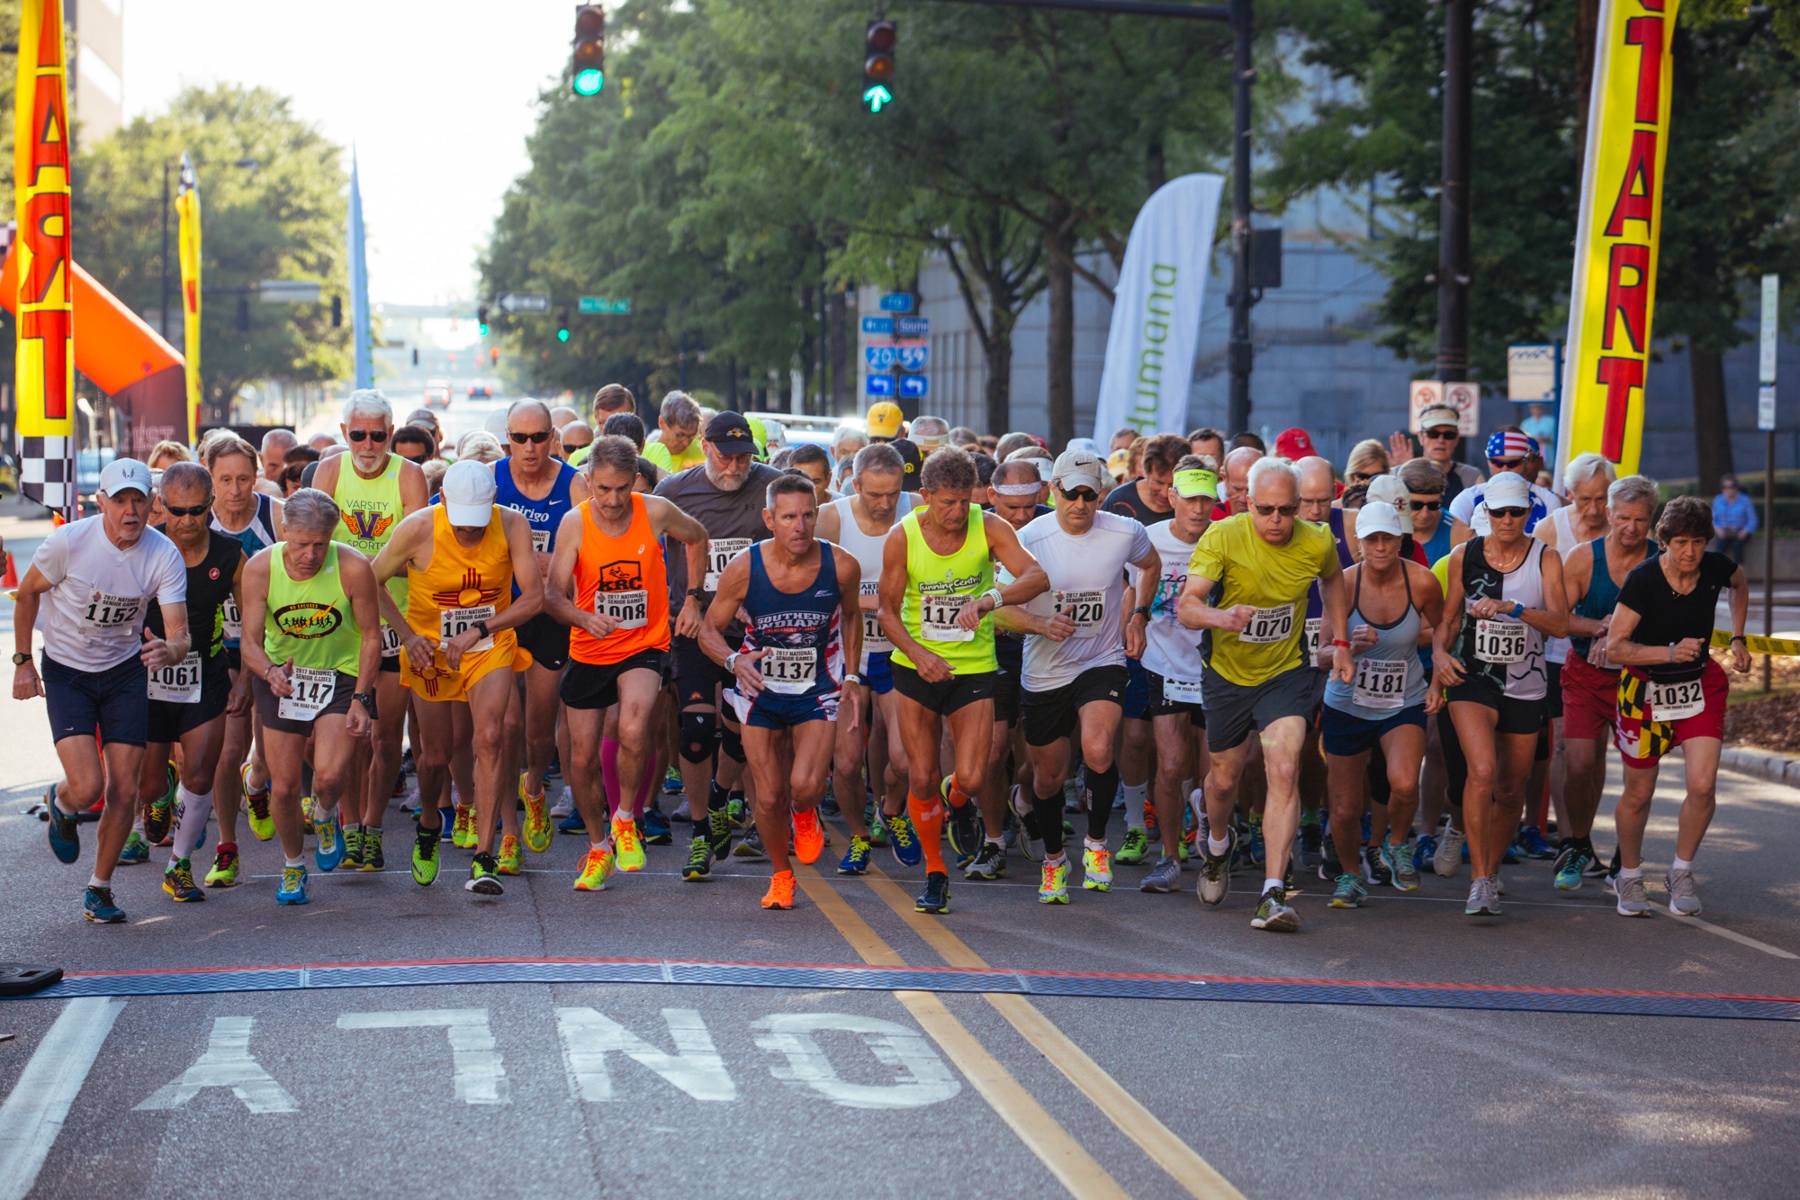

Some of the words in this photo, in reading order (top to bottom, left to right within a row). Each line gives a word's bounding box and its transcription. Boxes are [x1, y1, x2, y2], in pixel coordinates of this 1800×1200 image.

[1596, 0, 1664, 464] TART
[870, 348, 892, 364] 20
[902, 348, 924, 365] 59
[122, 425, 176, 453] EST
[346, 499, 388, 510] VARSITY
[510, 503, 550, 522] Dirigo
[352, 510, 382, 540] V
[706, 553, 737, 573] 10
[598, 576, 642, 592] KRC
[85, 604, 139, 623] 1152
[597, 603, 646, 620] 1008
[758, 612, 829, 624] SOUTHERN
[924, 606, 960, 624] 117
[444, 622, 468, 638] 10
[1243, 616, 1291, 636] 1070
[1478, 634, 1525, 656] 1036
[150, 666, 199, 686] 1061
[764, 661, 814, 679] 1137
[1358, 672, 1403, 692] 1181
[1653, 682, 1702, 706] 1032
[130, 1006, 962, 1115] ONLY
